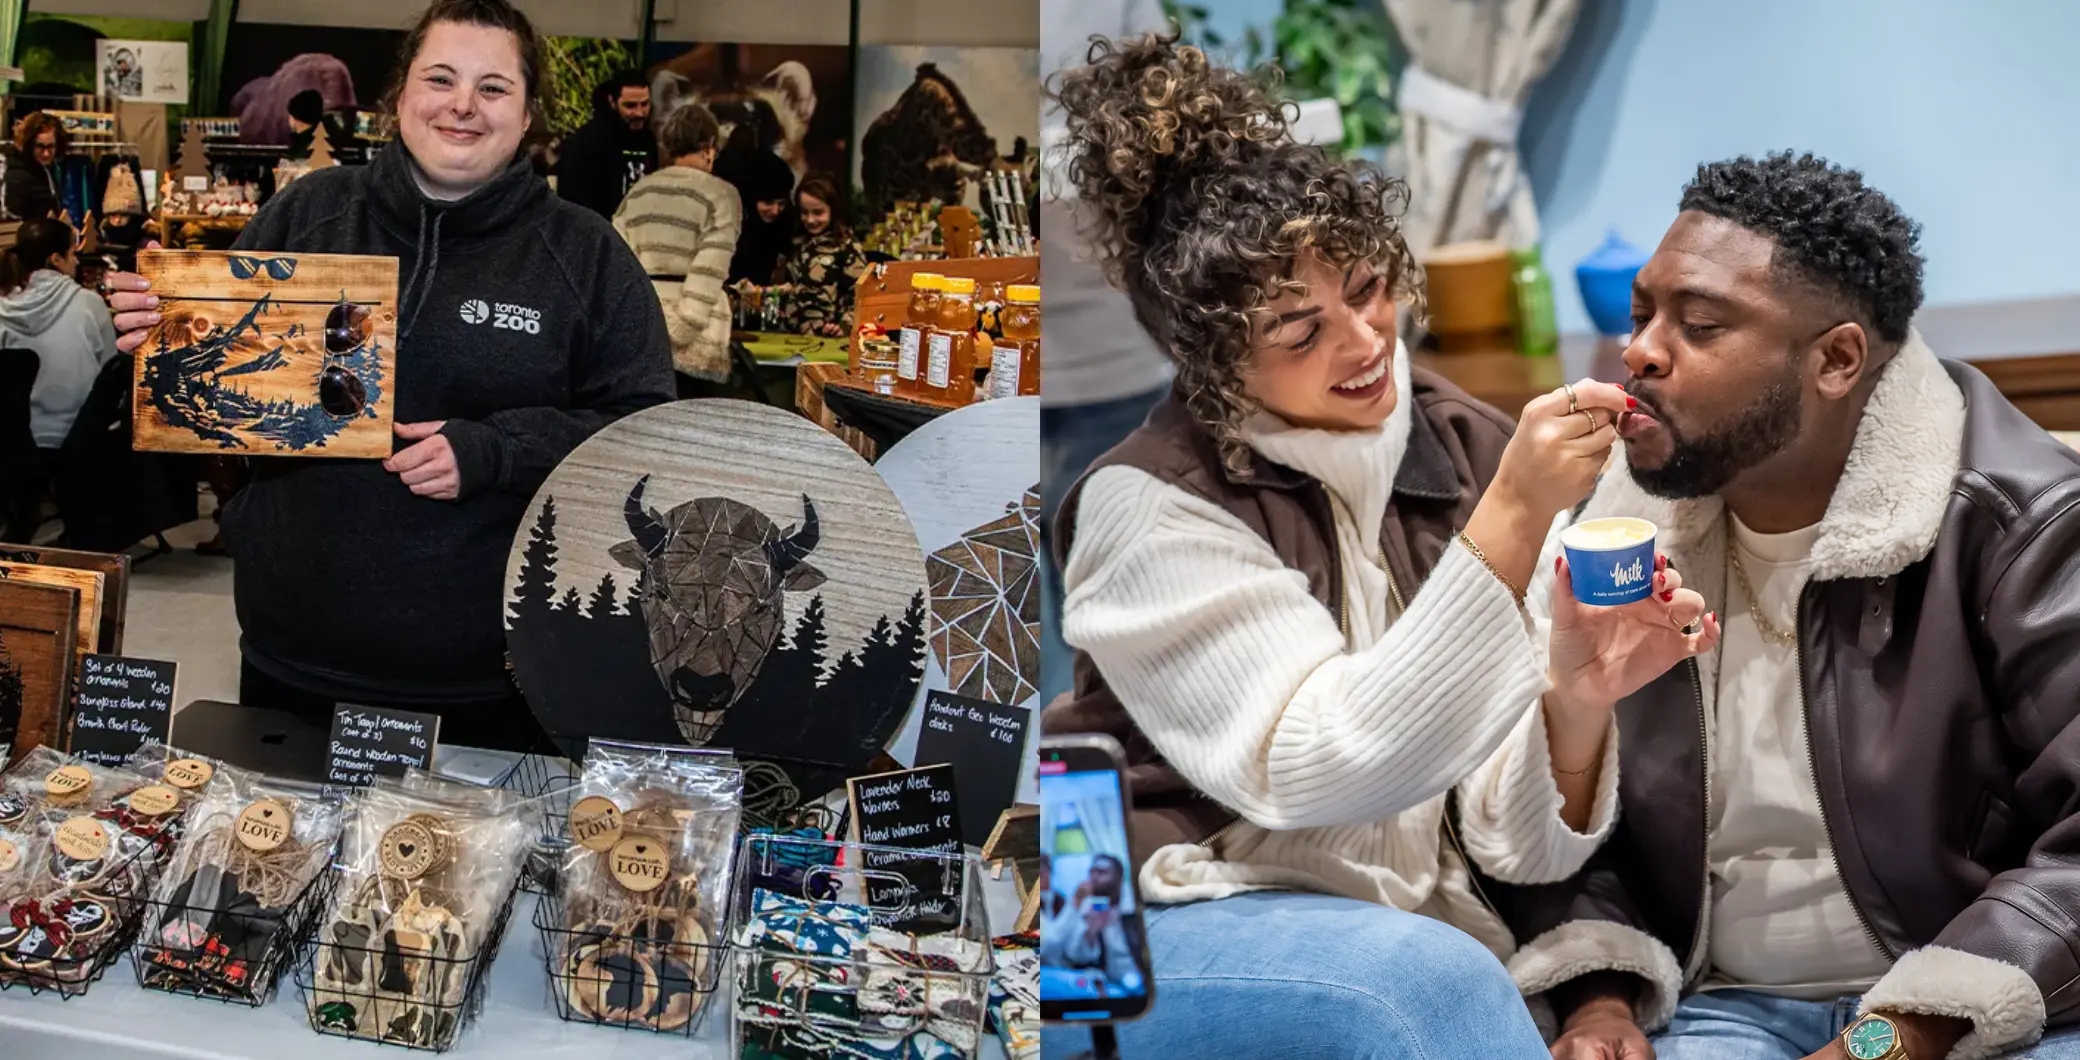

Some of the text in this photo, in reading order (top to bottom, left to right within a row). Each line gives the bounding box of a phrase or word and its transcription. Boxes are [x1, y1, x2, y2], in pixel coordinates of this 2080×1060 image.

[494, 302, 540, 320] toronto
[1610, 557, 1645, 587] Milk
[86, 658, 101, 672] Set
[117, 663, 124, 675] 4
[151, 682, 170, 694] $20
[338, 710, 353, 725] Tin
[331, 740, 361, 758] Round
[410, 736, 427, 749] $10
[860, 774, 932, 800] Lavender Neck
[241, 822, 282, 842] LOVE
[578, 818, 618, 840] LOVE
[864, 824, 890, 843] Hand
[618, 861, 663, 879] LOVE
